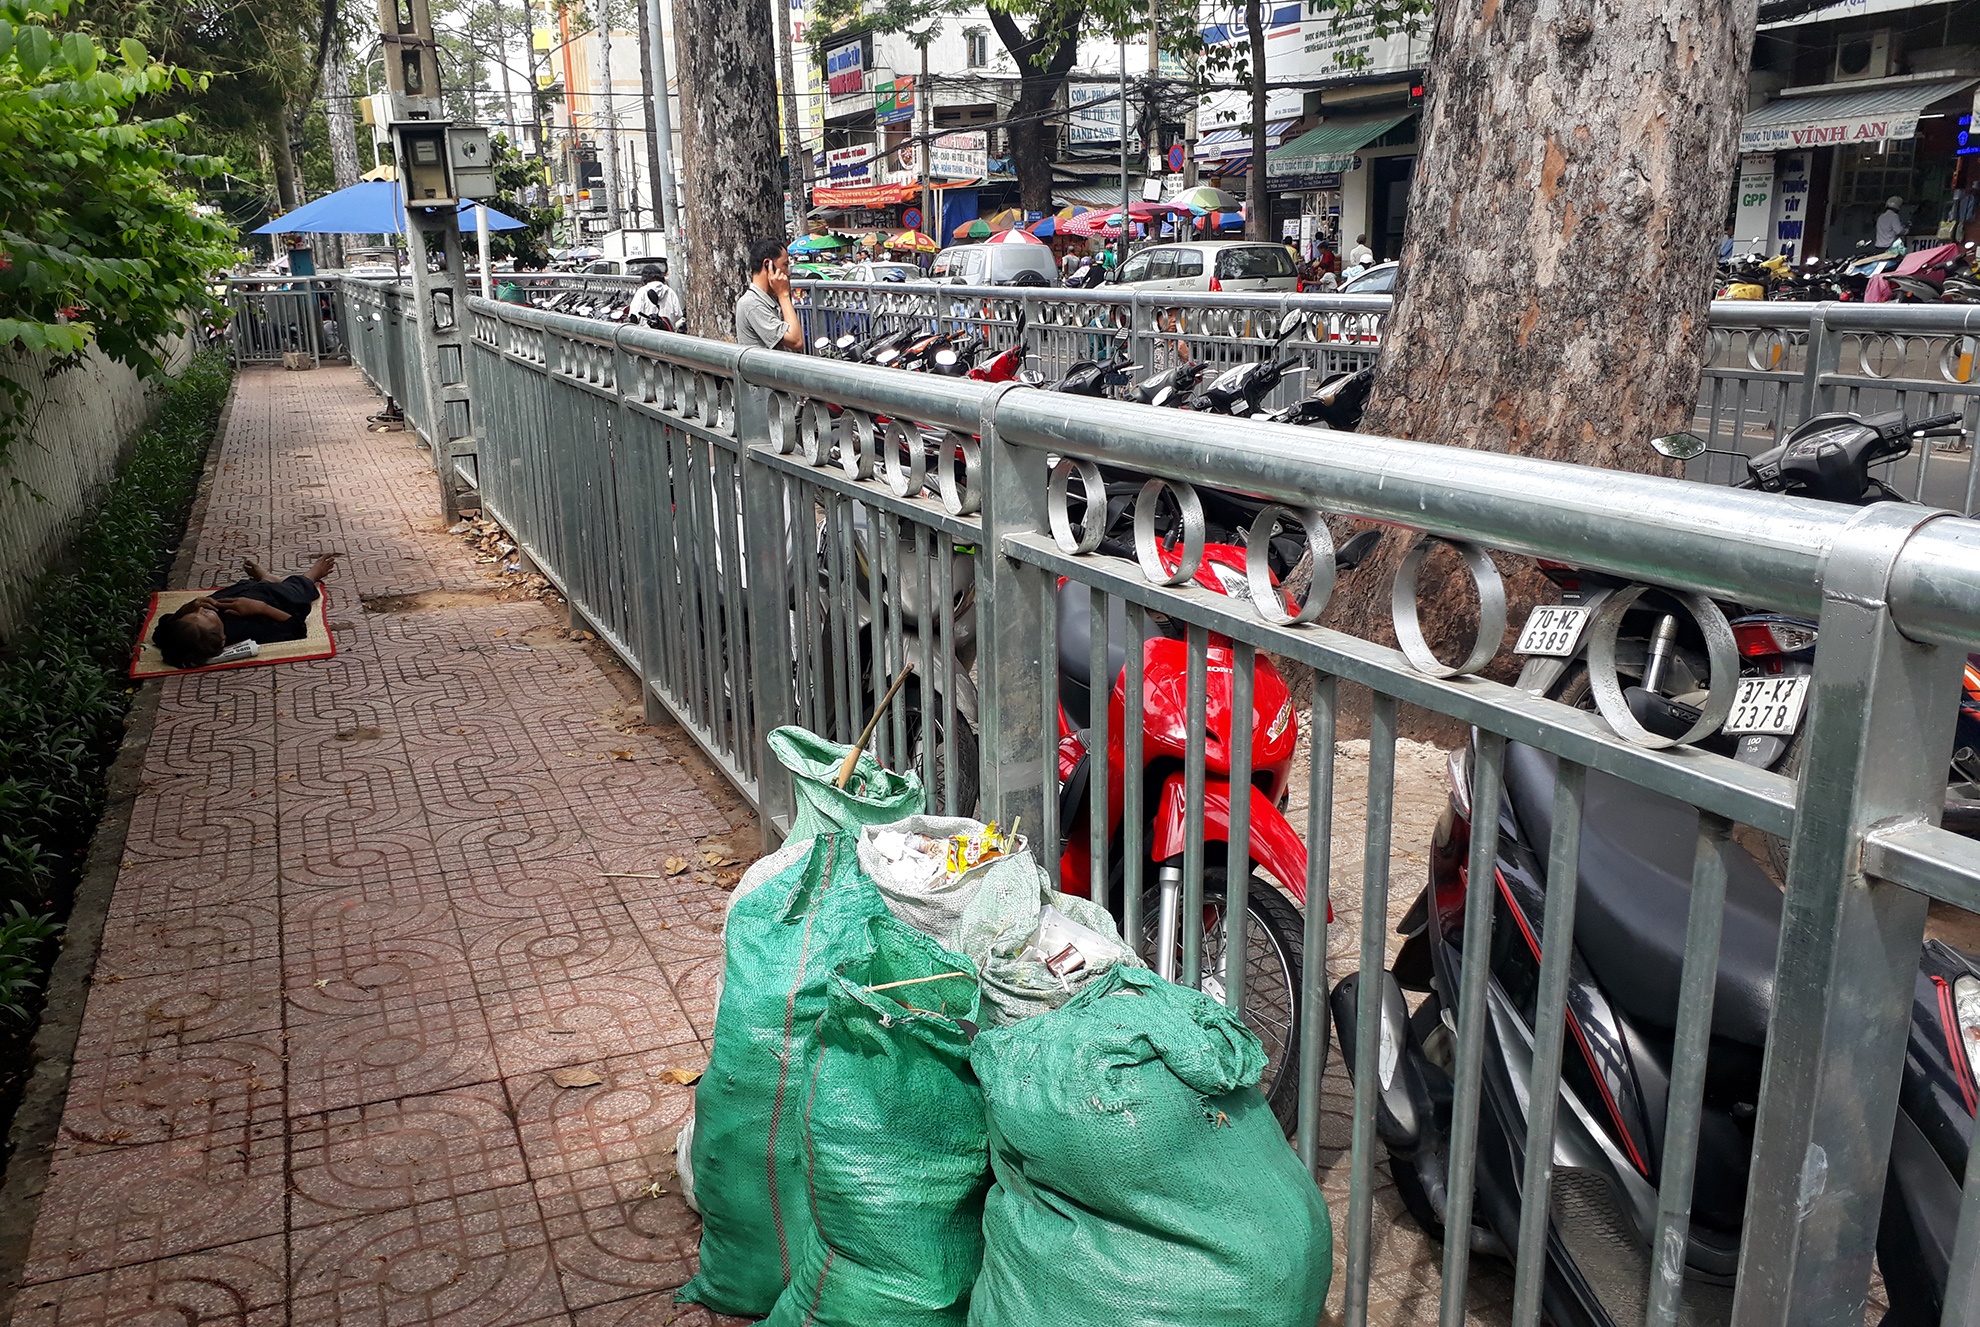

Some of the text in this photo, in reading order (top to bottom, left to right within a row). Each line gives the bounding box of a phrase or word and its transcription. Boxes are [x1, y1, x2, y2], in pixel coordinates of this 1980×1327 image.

[1791, 124, 1847, 145] VĨNH
[1854, 121, 1888, 139] AN
[1743, 193, 1767, 207] GPP
[1785, 195, 1800, 211] TÂY
[1533, 609, 1579, 630] 70-M2
[1524, 631, 1569, 651] 6389
[1741, 680, 1797, 704] 37-K7
[1733, 705, 1788, 728] 2378
